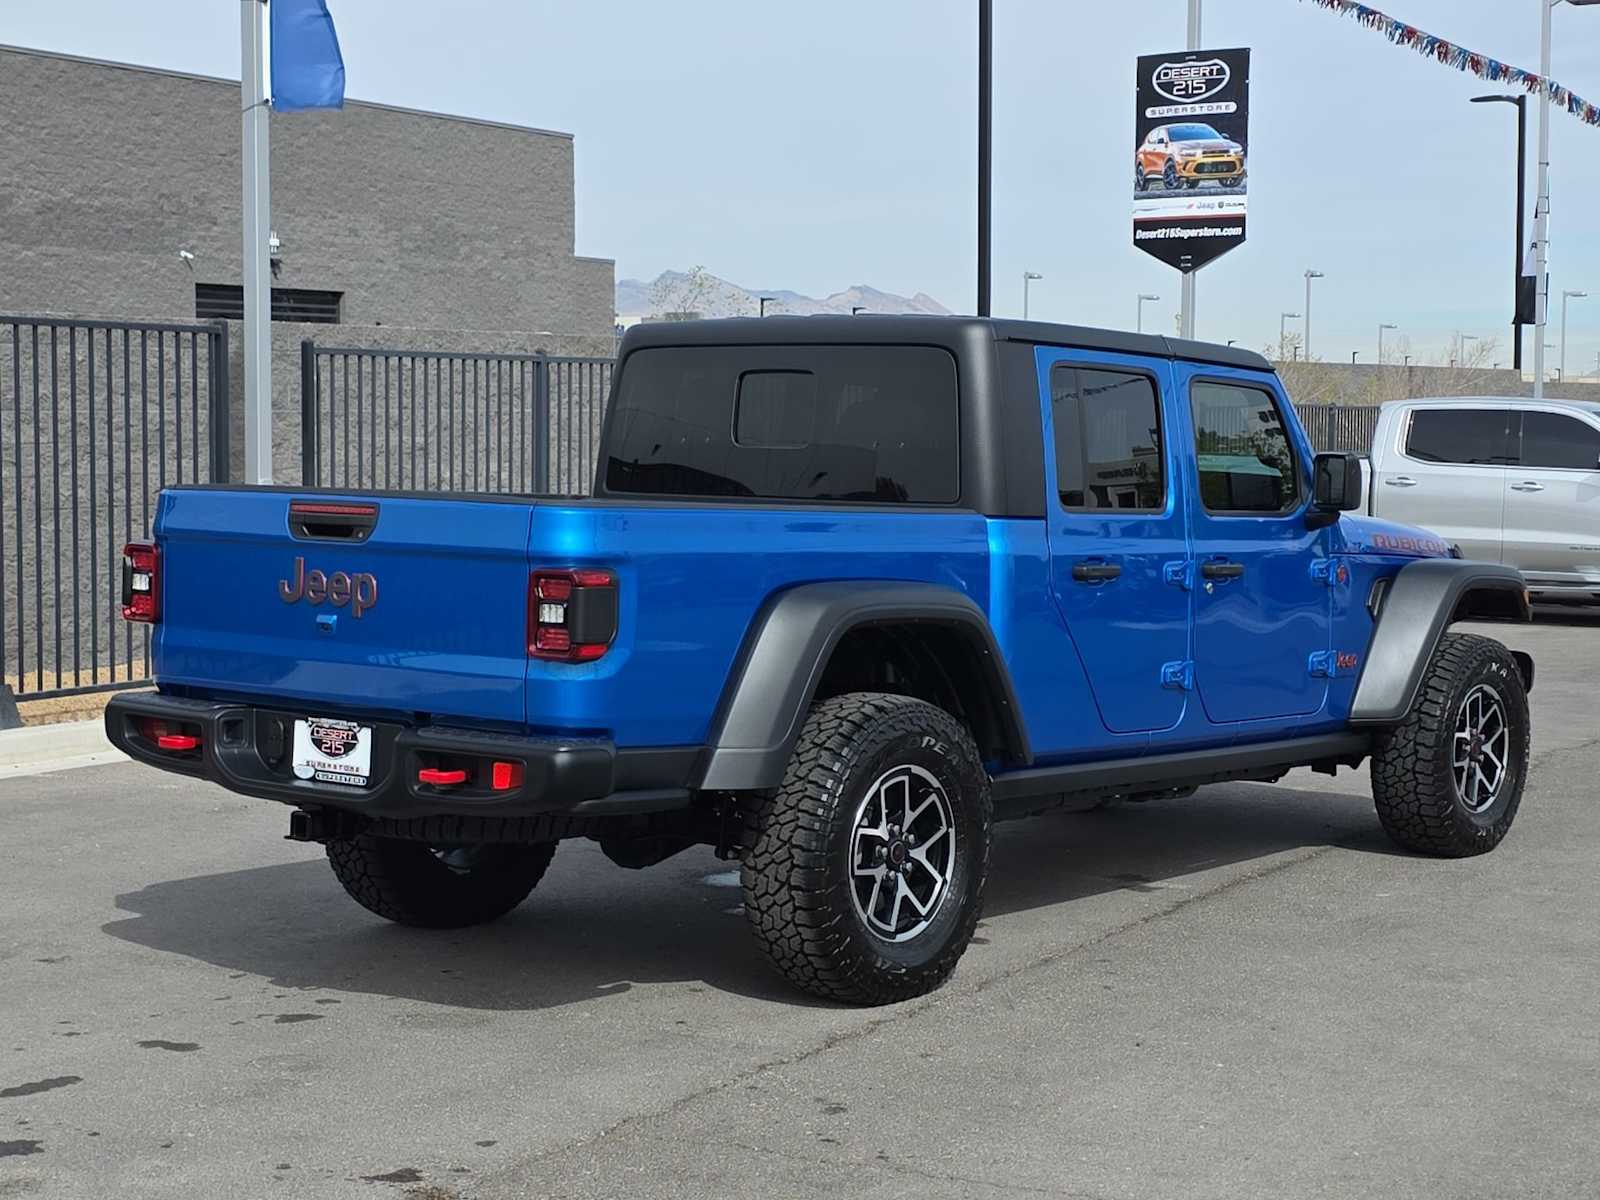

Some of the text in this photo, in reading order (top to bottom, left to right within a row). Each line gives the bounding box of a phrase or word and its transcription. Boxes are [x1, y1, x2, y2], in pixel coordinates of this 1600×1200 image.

[1160, 64, 1221, 81] DESERT
[1172, 79, 1207, 96] 215
[1149, 103, 1232, 117] SUPERSTORE
[1135, 226, 1243, 240] Desert215Superstore.com
[1372, 534, 1446, 553] RUBICON
[279, 556, 377, 618] Jeep
[313, 726, 354, 741] DESERT
[321, 739, 345, 754] 215
